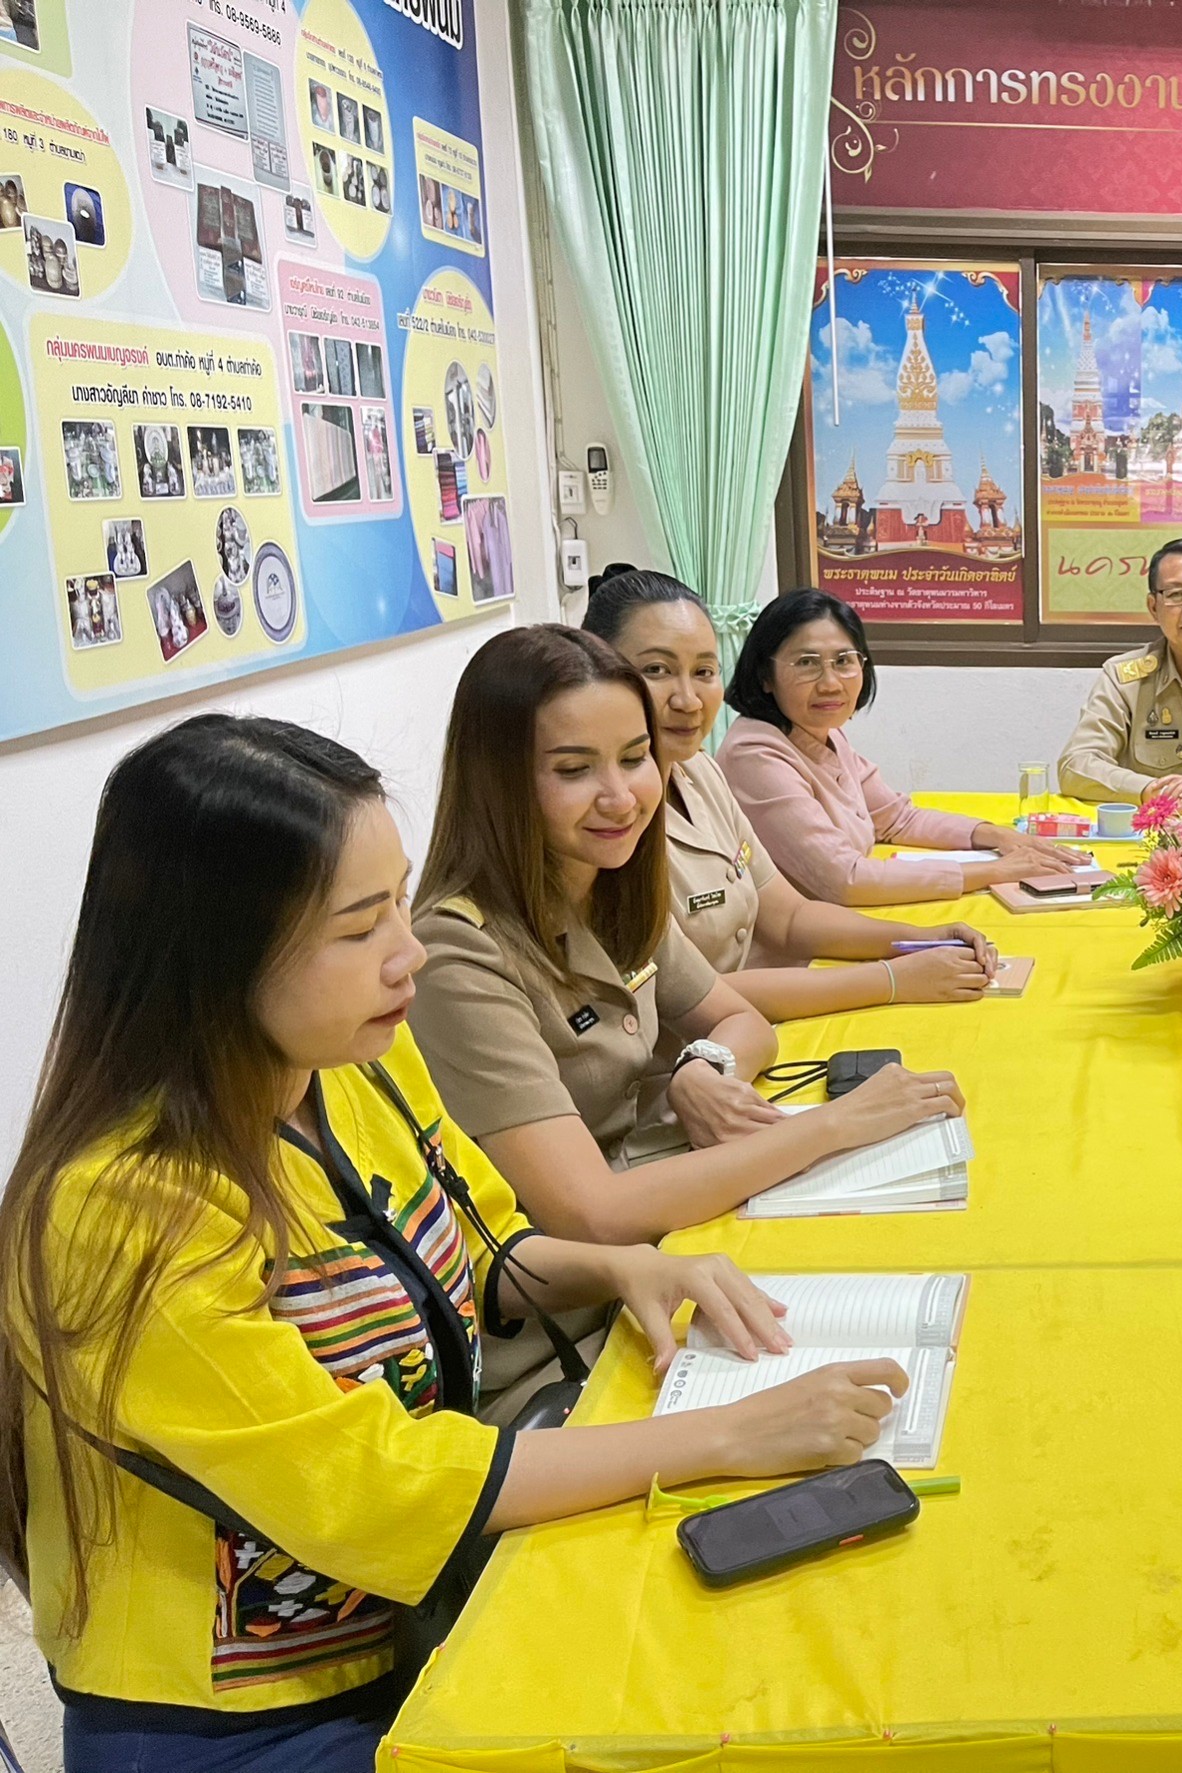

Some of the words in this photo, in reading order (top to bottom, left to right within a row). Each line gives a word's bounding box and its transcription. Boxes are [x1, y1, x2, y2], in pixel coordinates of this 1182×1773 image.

[218, 357, 224, 372] 4
[190, 392, 252, 411] 08-7192-5410
[823, 567, 898, 585] พระธาตุพนม
